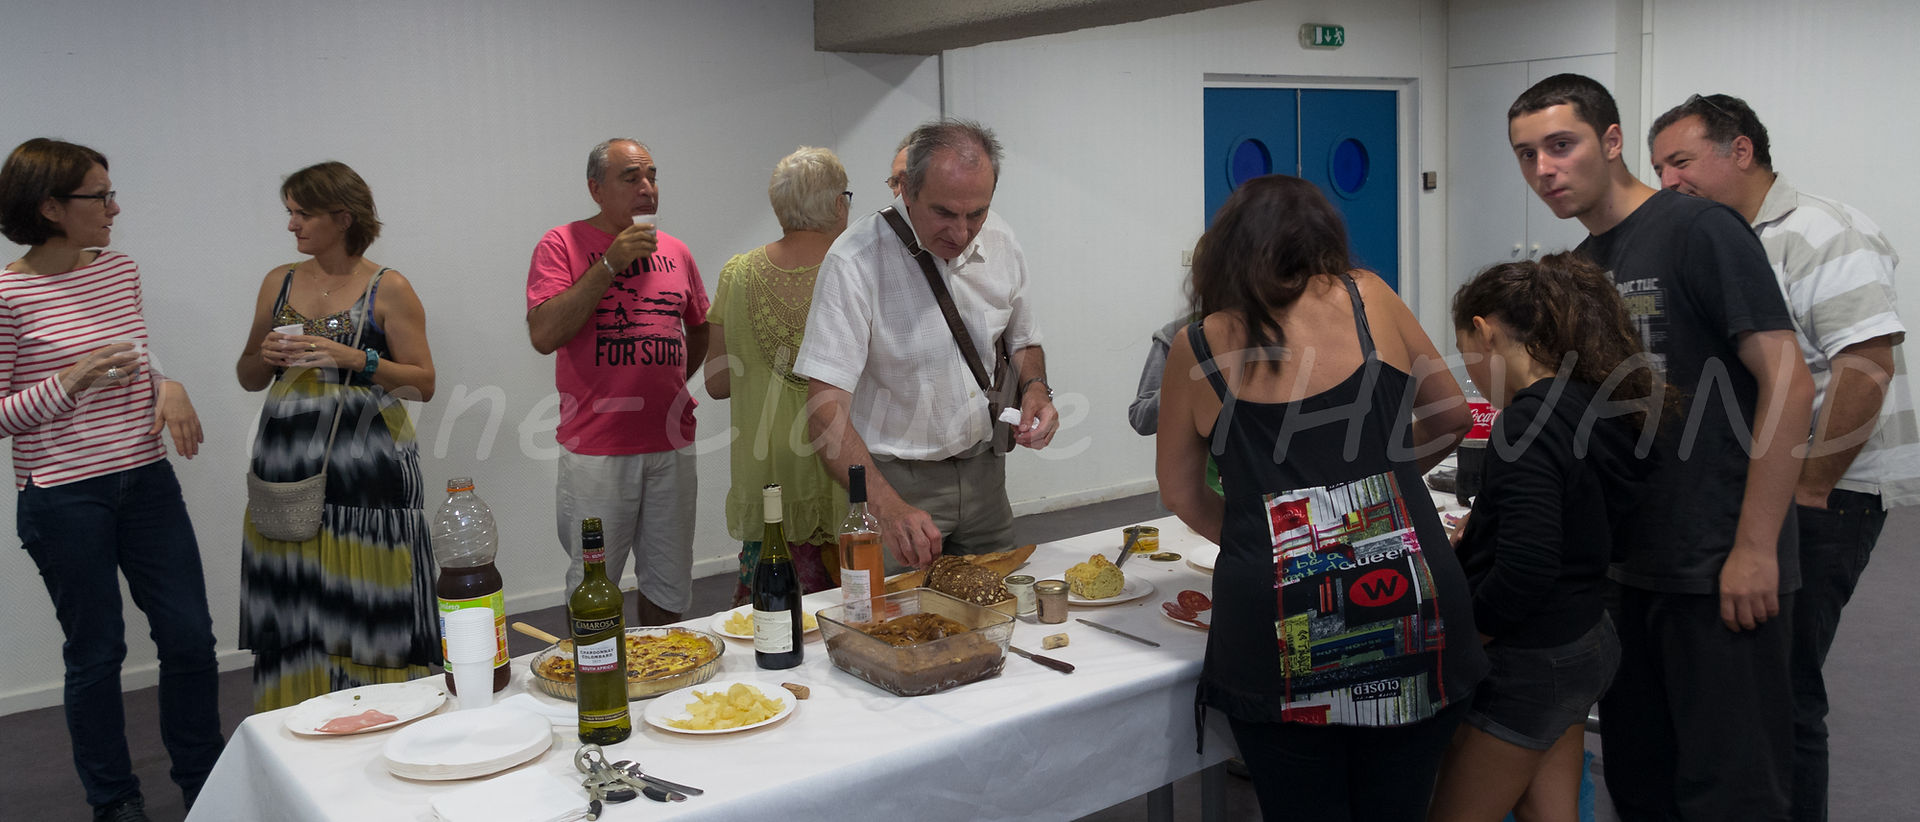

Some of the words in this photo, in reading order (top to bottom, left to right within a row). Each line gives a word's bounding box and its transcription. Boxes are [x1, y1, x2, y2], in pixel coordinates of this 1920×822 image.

[596, 338, 636, 367] FOR
[1339, 547, 1412, 570] Queen
[1361, 576, 1398, 600] W
[576, 619, 615, 630] CIMAROSA
[580, 648, 614, 656] CHARDONNAY
[1353, 680, 1400, 695] CLOSED
